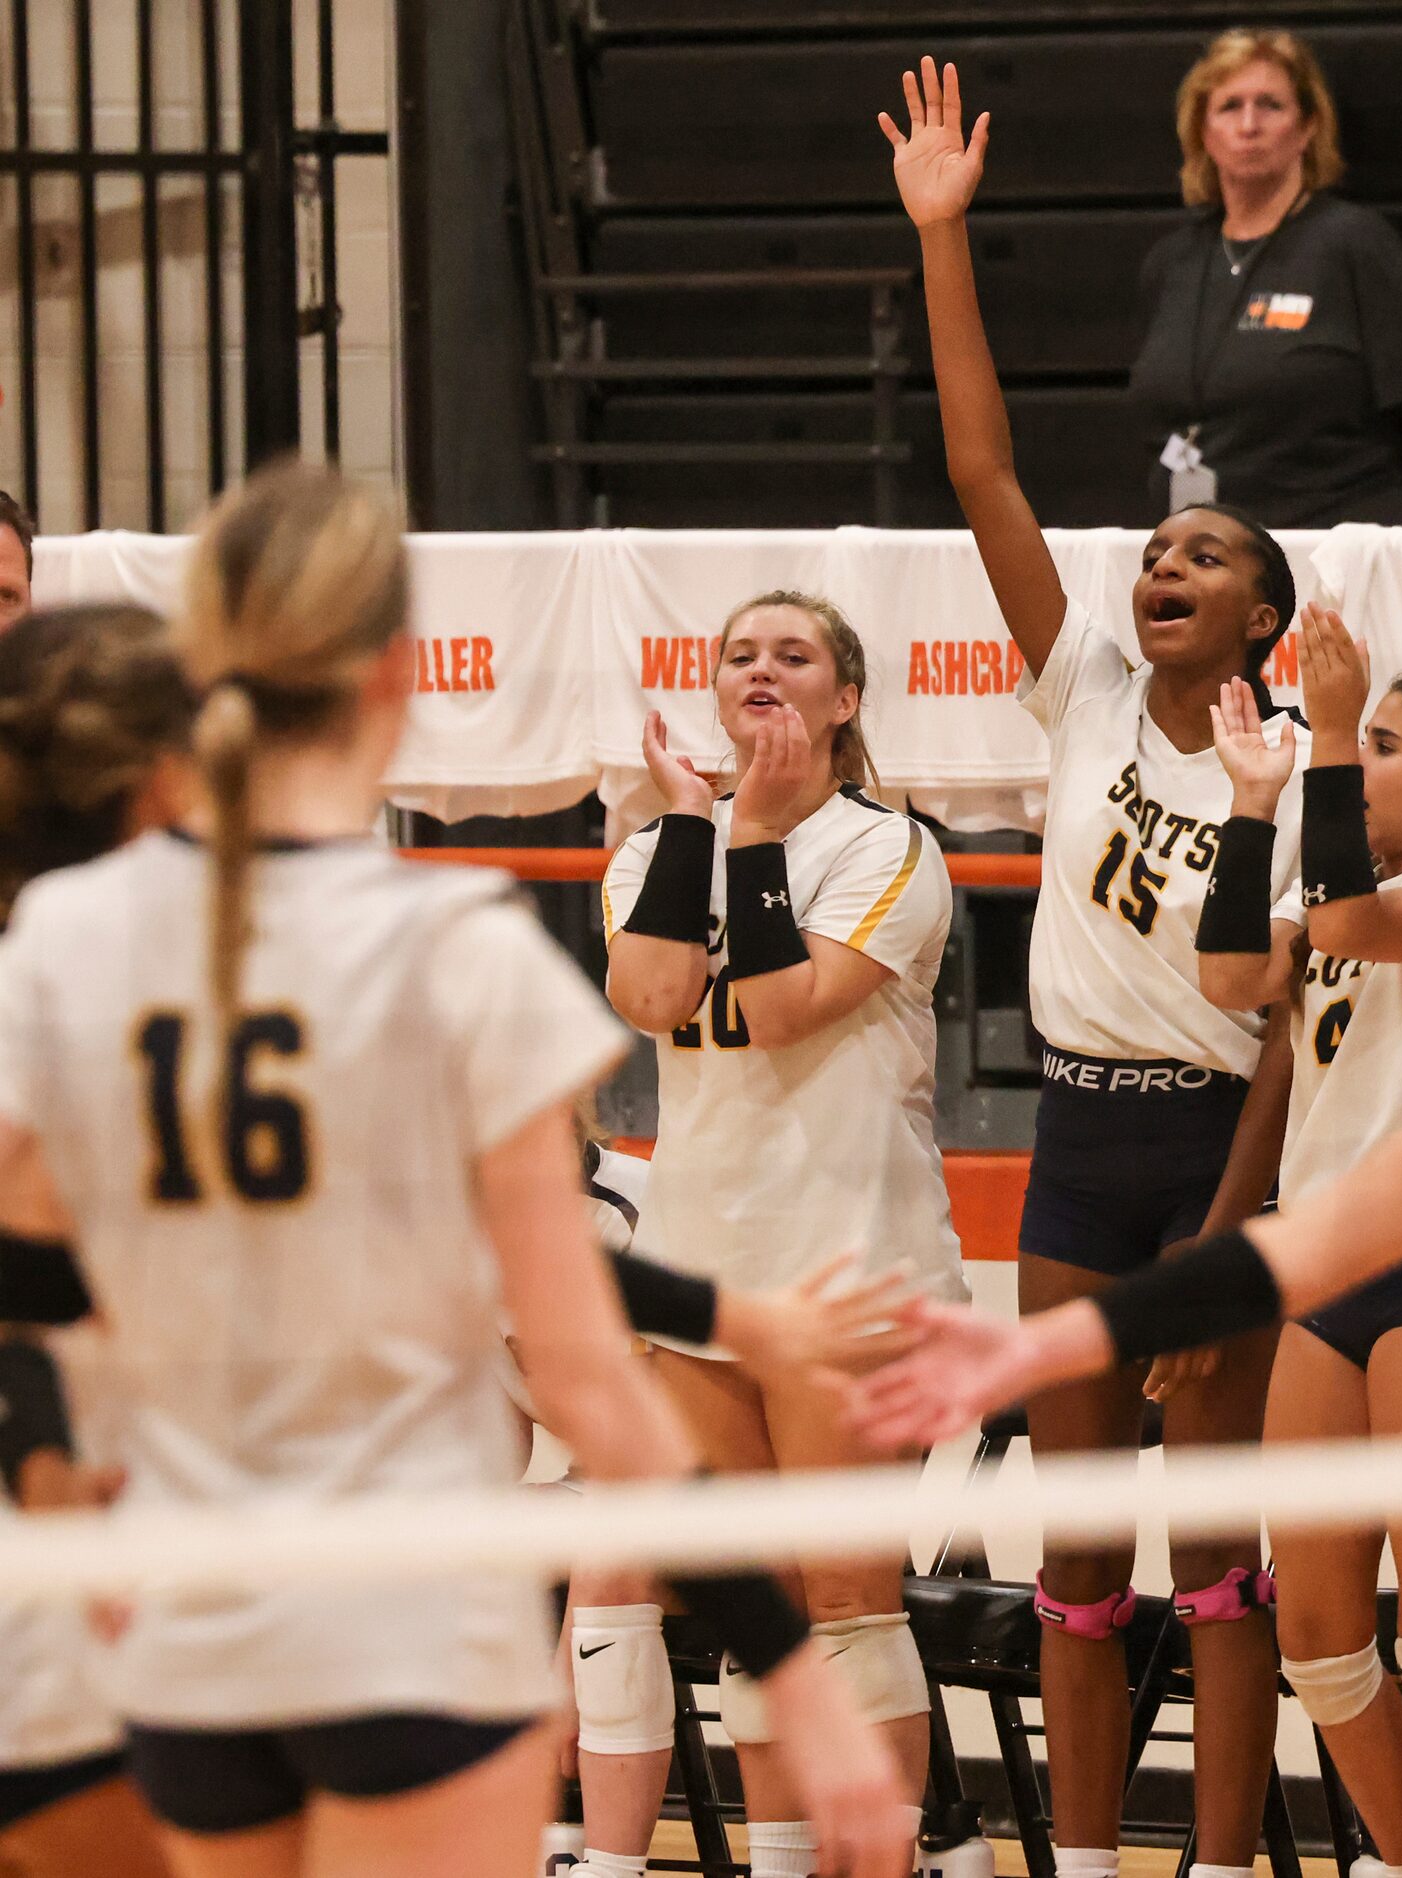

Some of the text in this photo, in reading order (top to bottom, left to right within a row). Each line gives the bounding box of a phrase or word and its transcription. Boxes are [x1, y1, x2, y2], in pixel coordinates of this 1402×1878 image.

[641, 636, 722, 690] WEI
[1090, 828, 1170, 937] 15
[132, 1005, 312, 1210] 16
[1042, 1048, 1213, 1093] NIKE PRO
